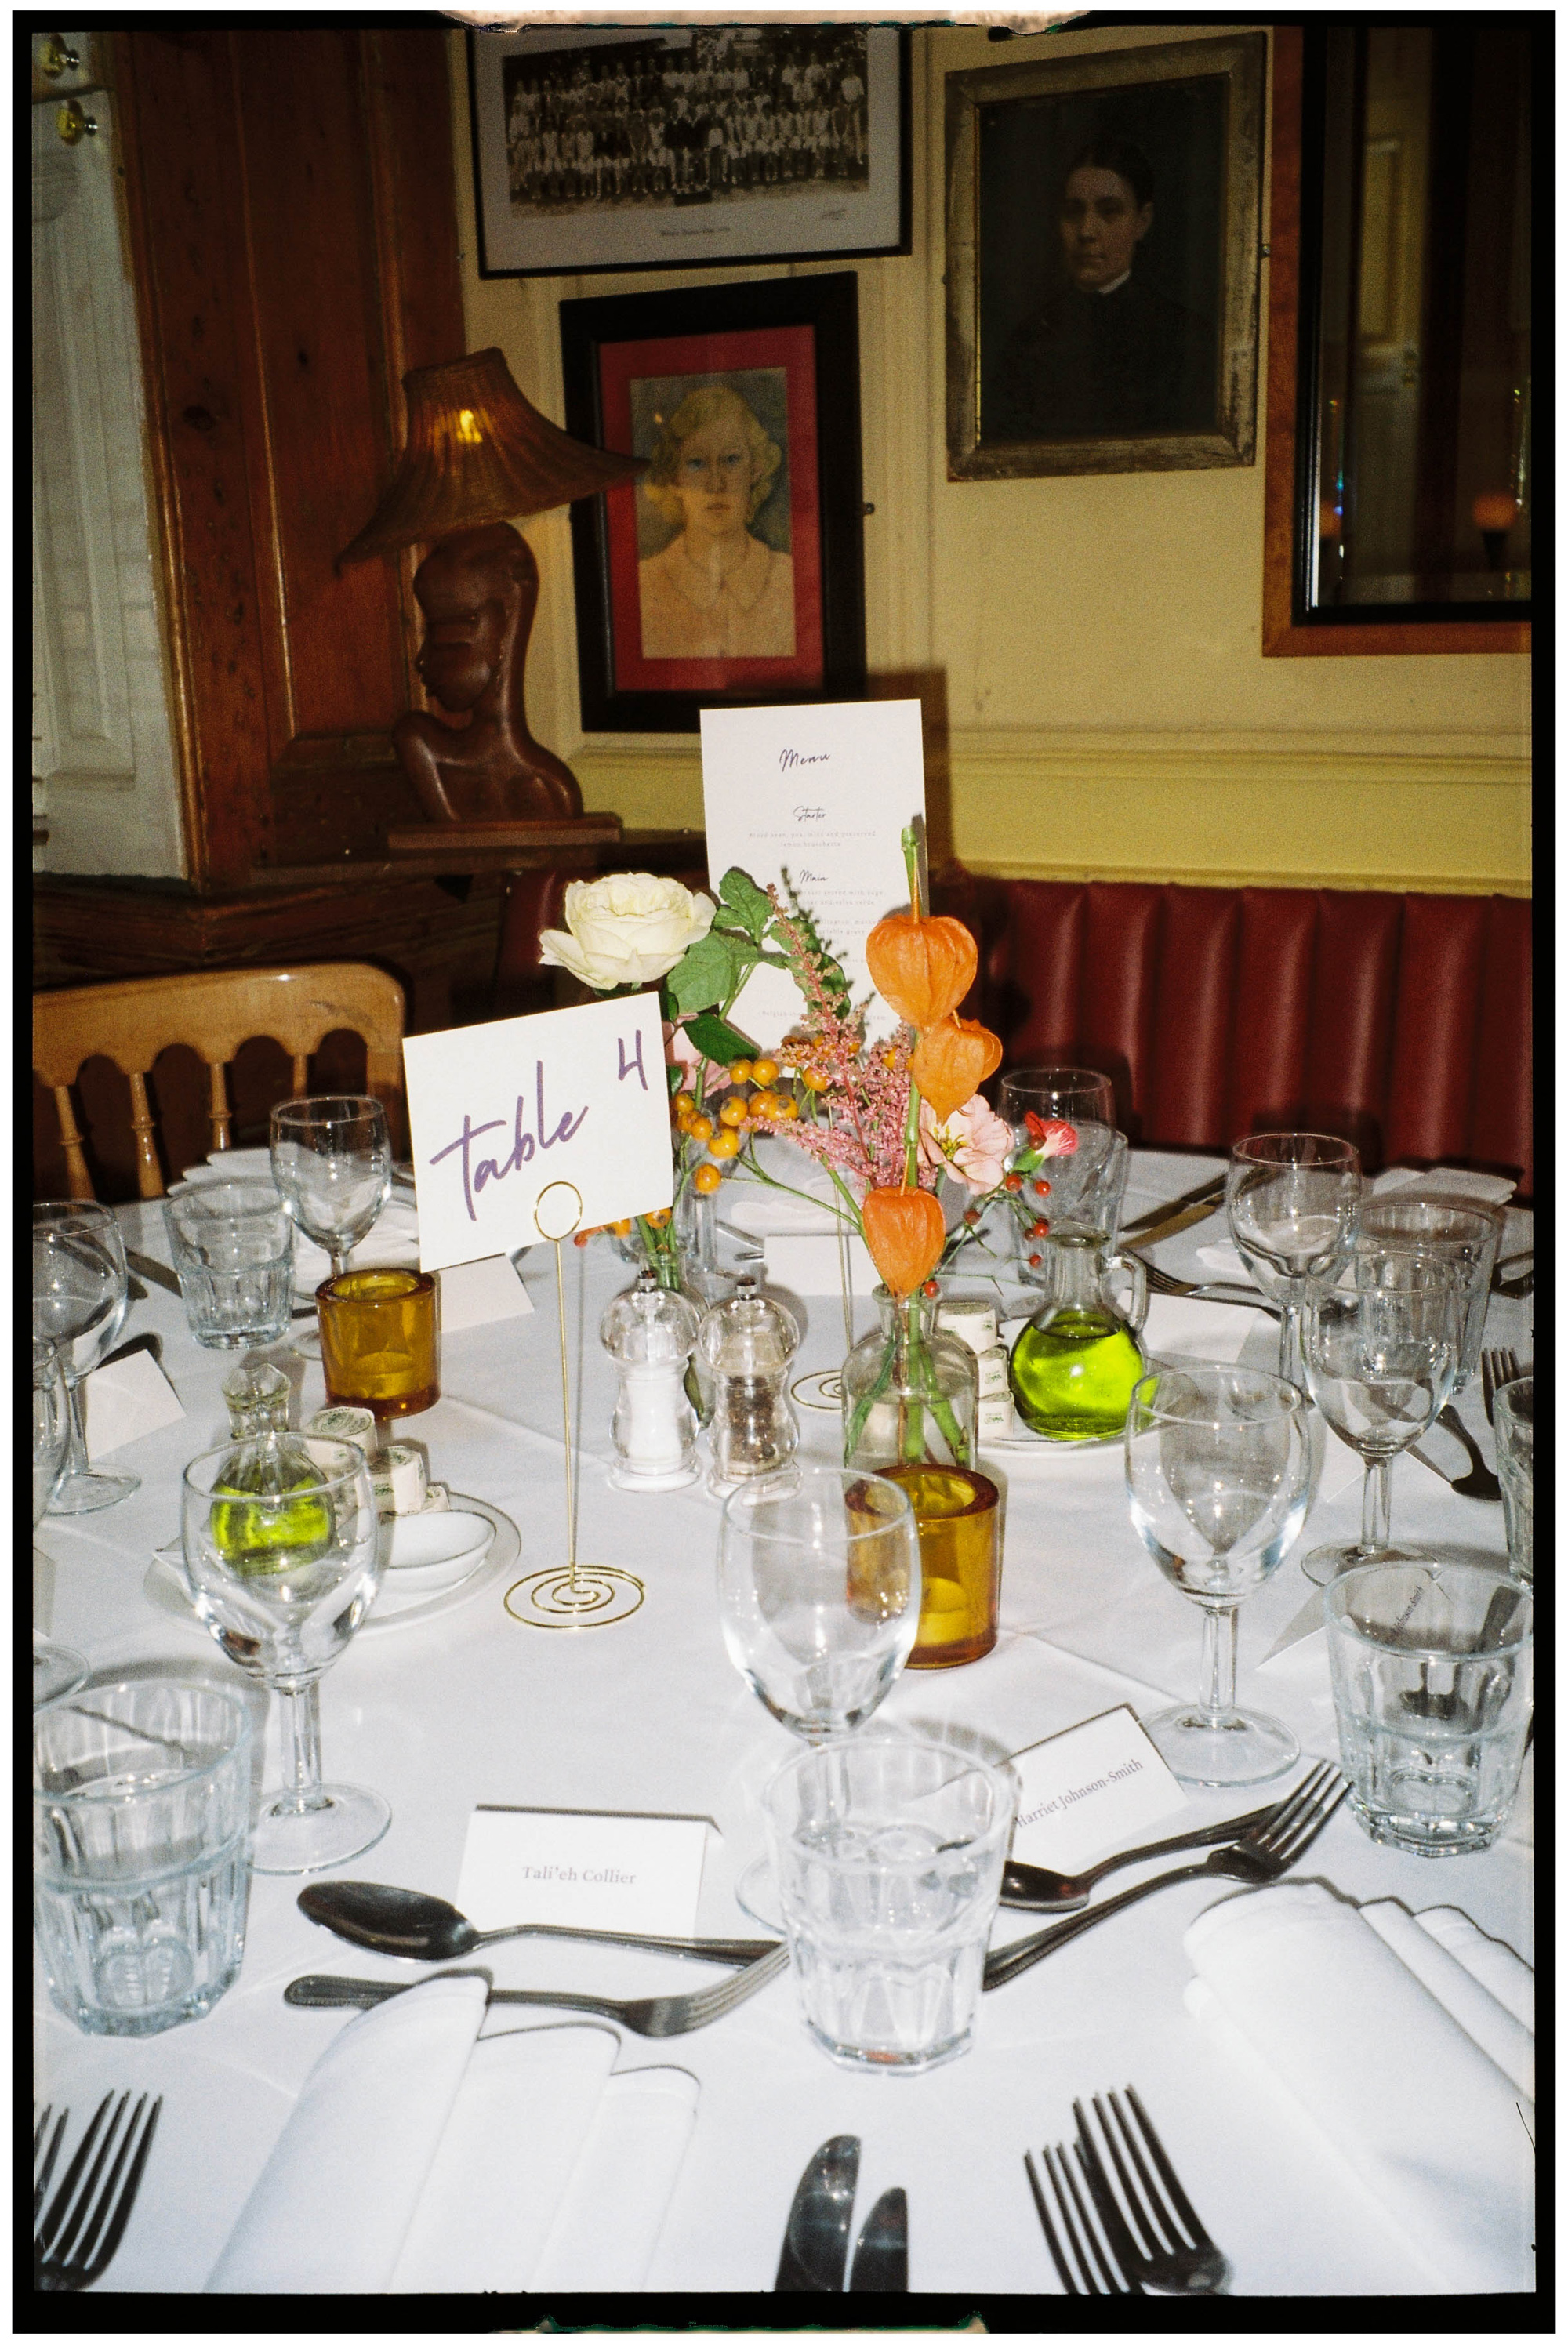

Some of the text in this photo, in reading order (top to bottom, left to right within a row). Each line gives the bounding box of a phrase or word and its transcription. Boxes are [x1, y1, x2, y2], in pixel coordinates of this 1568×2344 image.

[779, 749, 831, 772] Menu
[793, 805, 827, 822] Starter
[798, 869, 829, 884] Main
[617, 1029, 649, 1090] 4
[1014, 1758, 1144, 1828] Harriet Johnson-Smith
[583, 1869, 637, 1884] Collier
